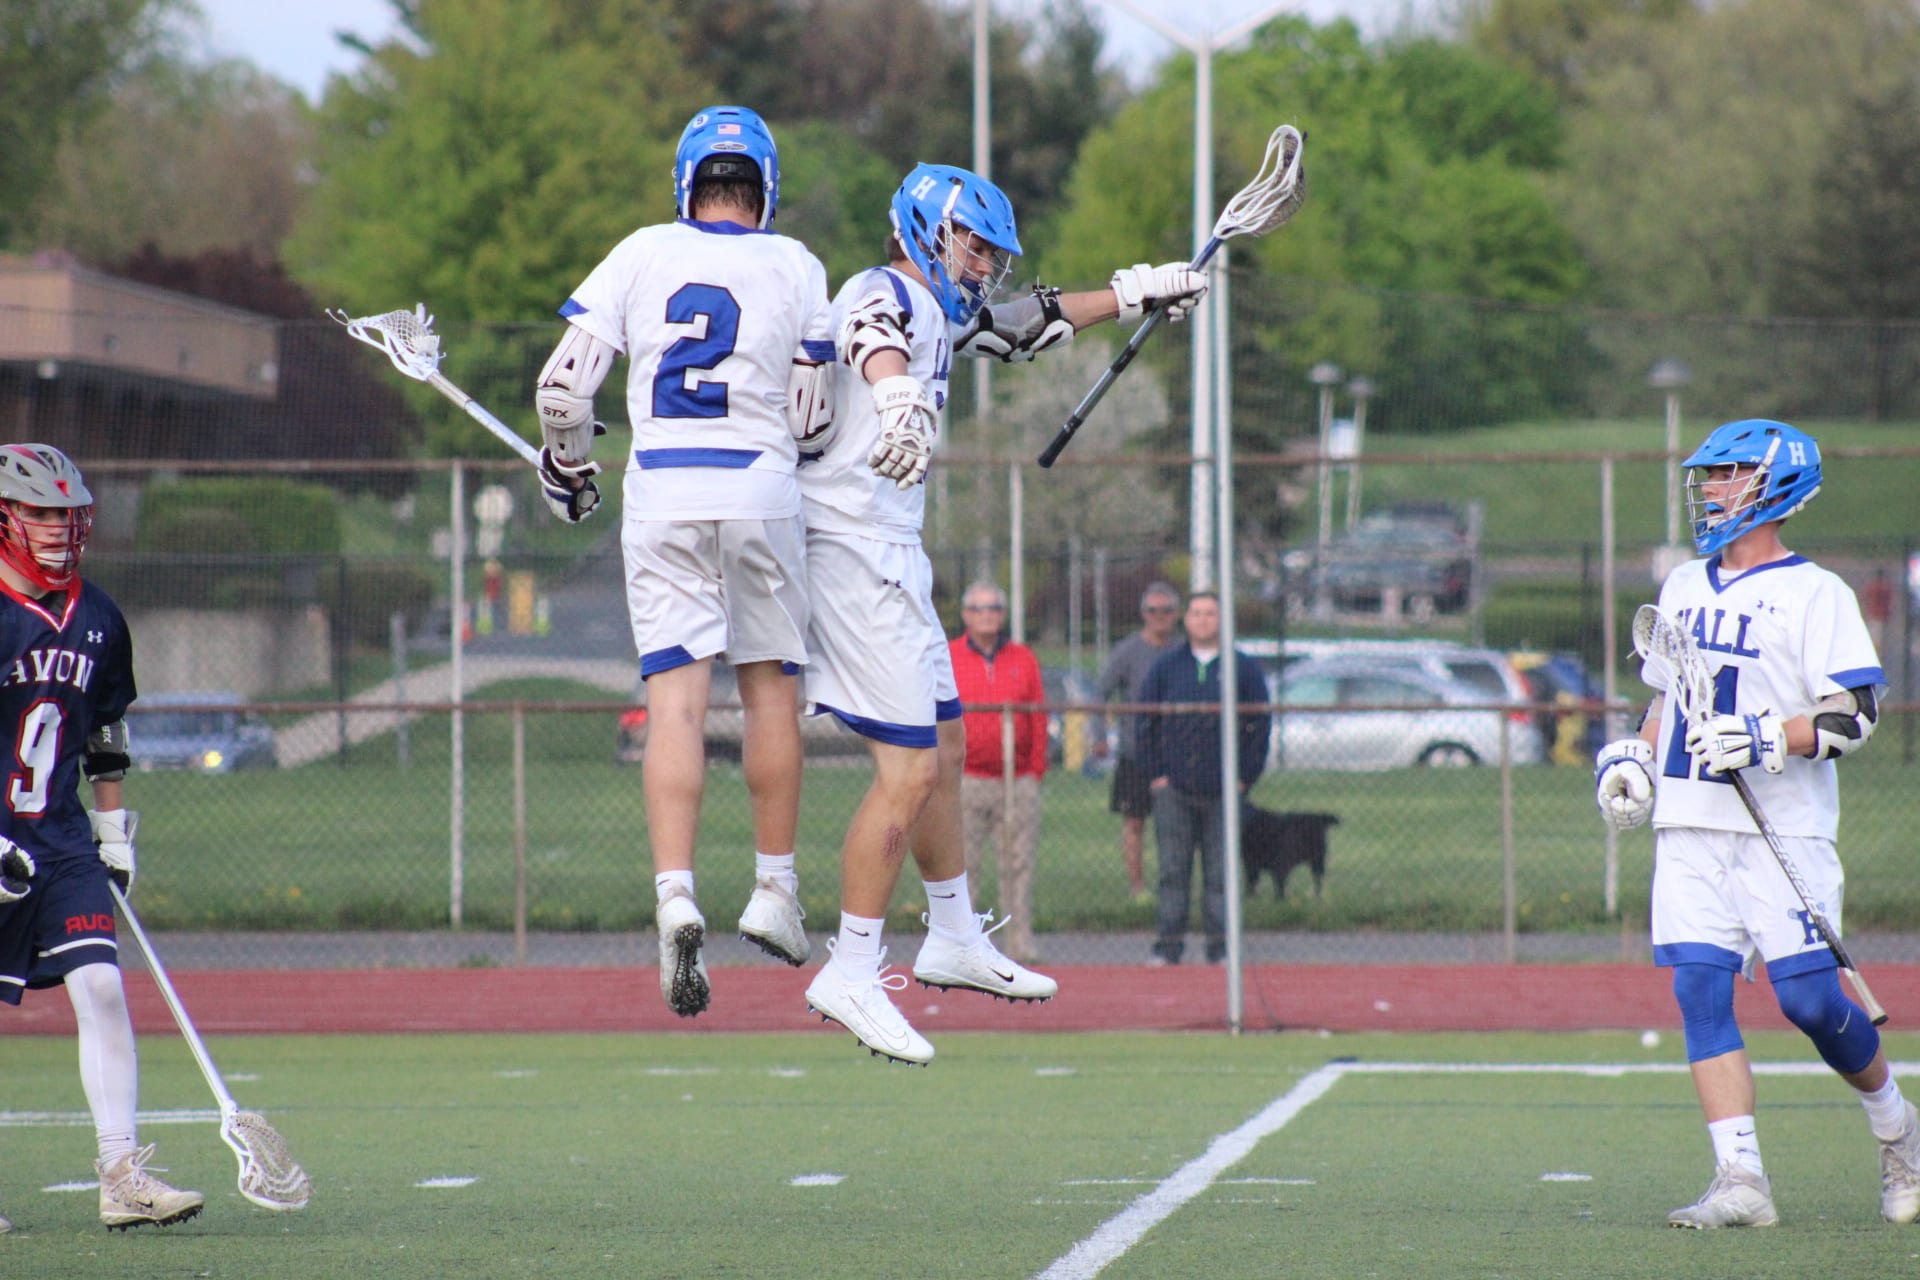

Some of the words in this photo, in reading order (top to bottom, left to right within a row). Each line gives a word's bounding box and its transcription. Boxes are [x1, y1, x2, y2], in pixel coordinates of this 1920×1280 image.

[910, 175, 937, 200] H
[652, 282, 742, 418] 2
[543, 406, 568, 418] STX
[1788, 442, 1807, 465] H
[1678, 606, 1760, 659] ALL
[3, 649, 94, 693] AVON
[6, 698, 67, 818] 9
